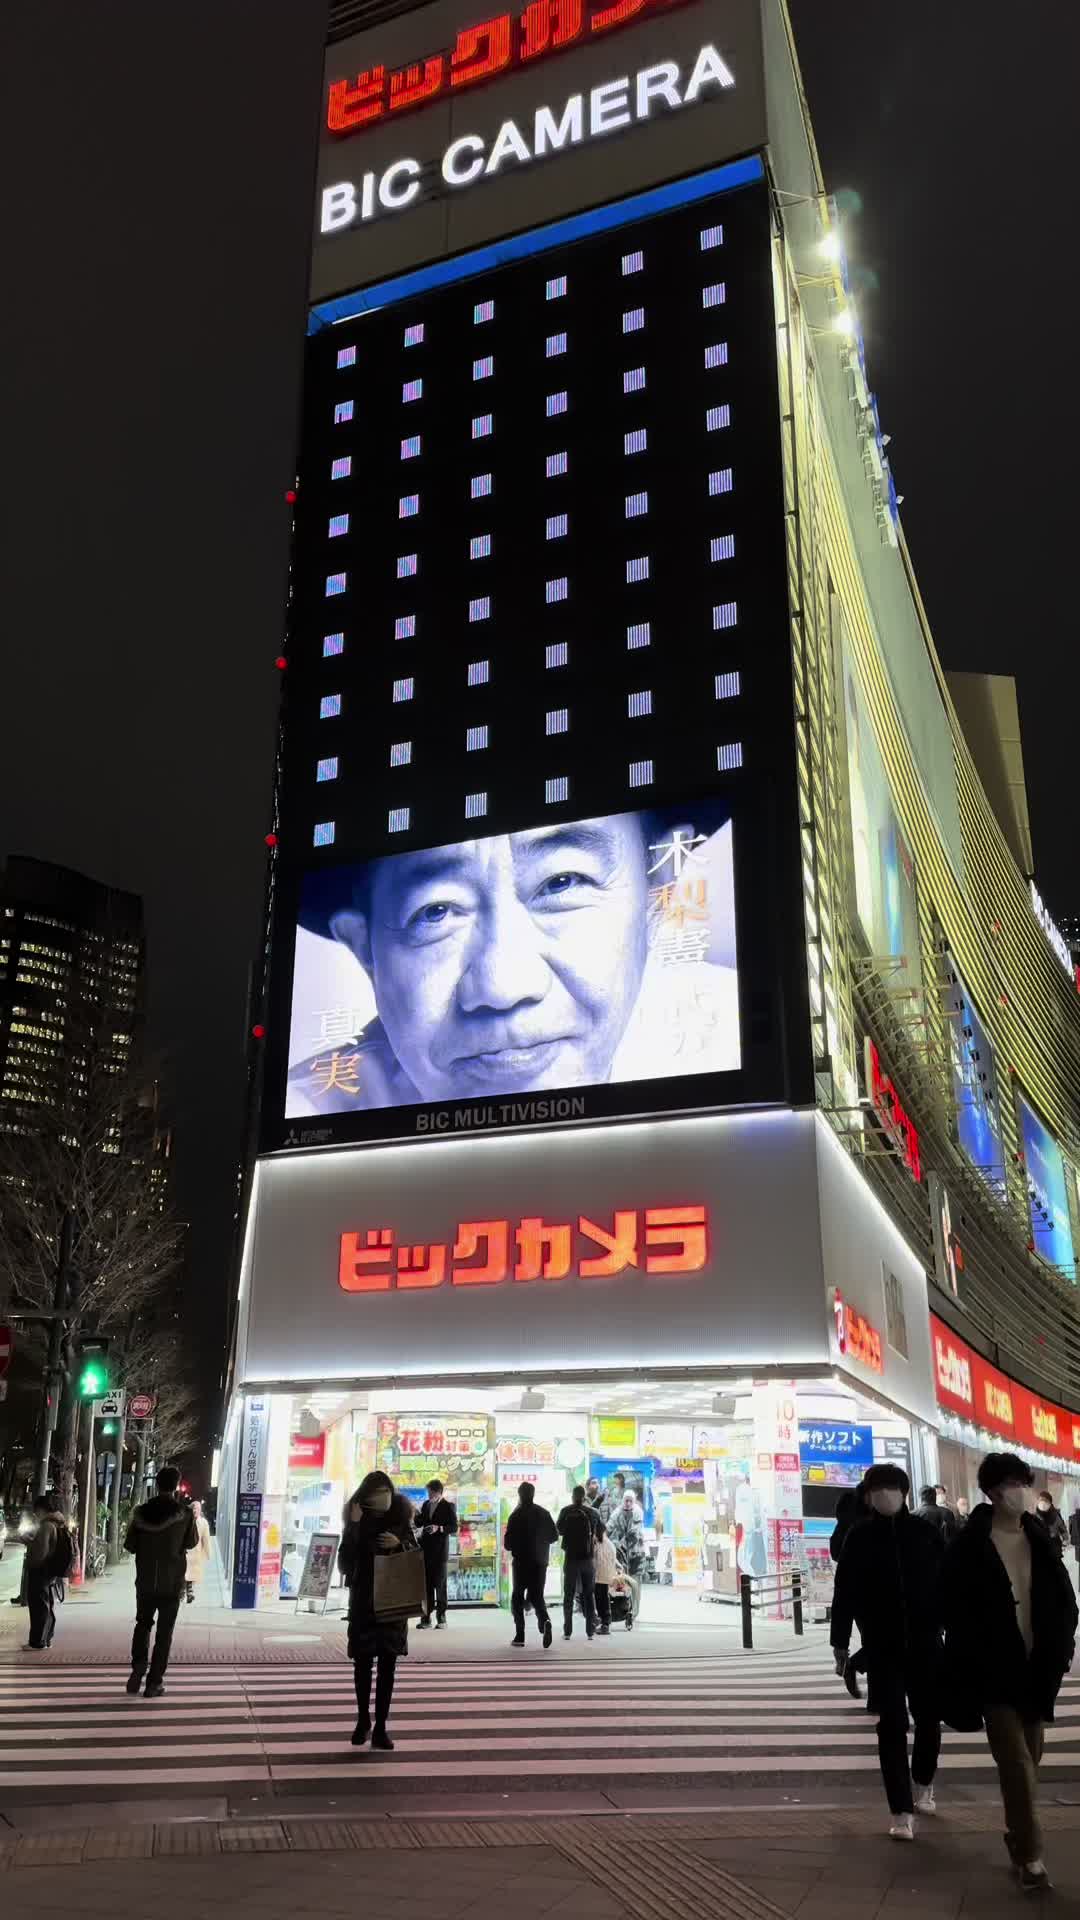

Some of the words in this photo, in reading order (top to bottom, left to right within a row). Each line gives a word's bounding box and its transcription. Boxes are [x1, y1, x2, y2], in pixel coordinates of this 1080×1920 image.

[321, 159, 421, 233] BIC
[441, 44, 735, 185] CAMERA
[309, 1006, 365, 1098] 真実
[416, 1110, 450, 1131] BIC
[454, 1096, 586, 1129] MULTIVISION
[339, 1205, 708, 1293] ビックカメラ
